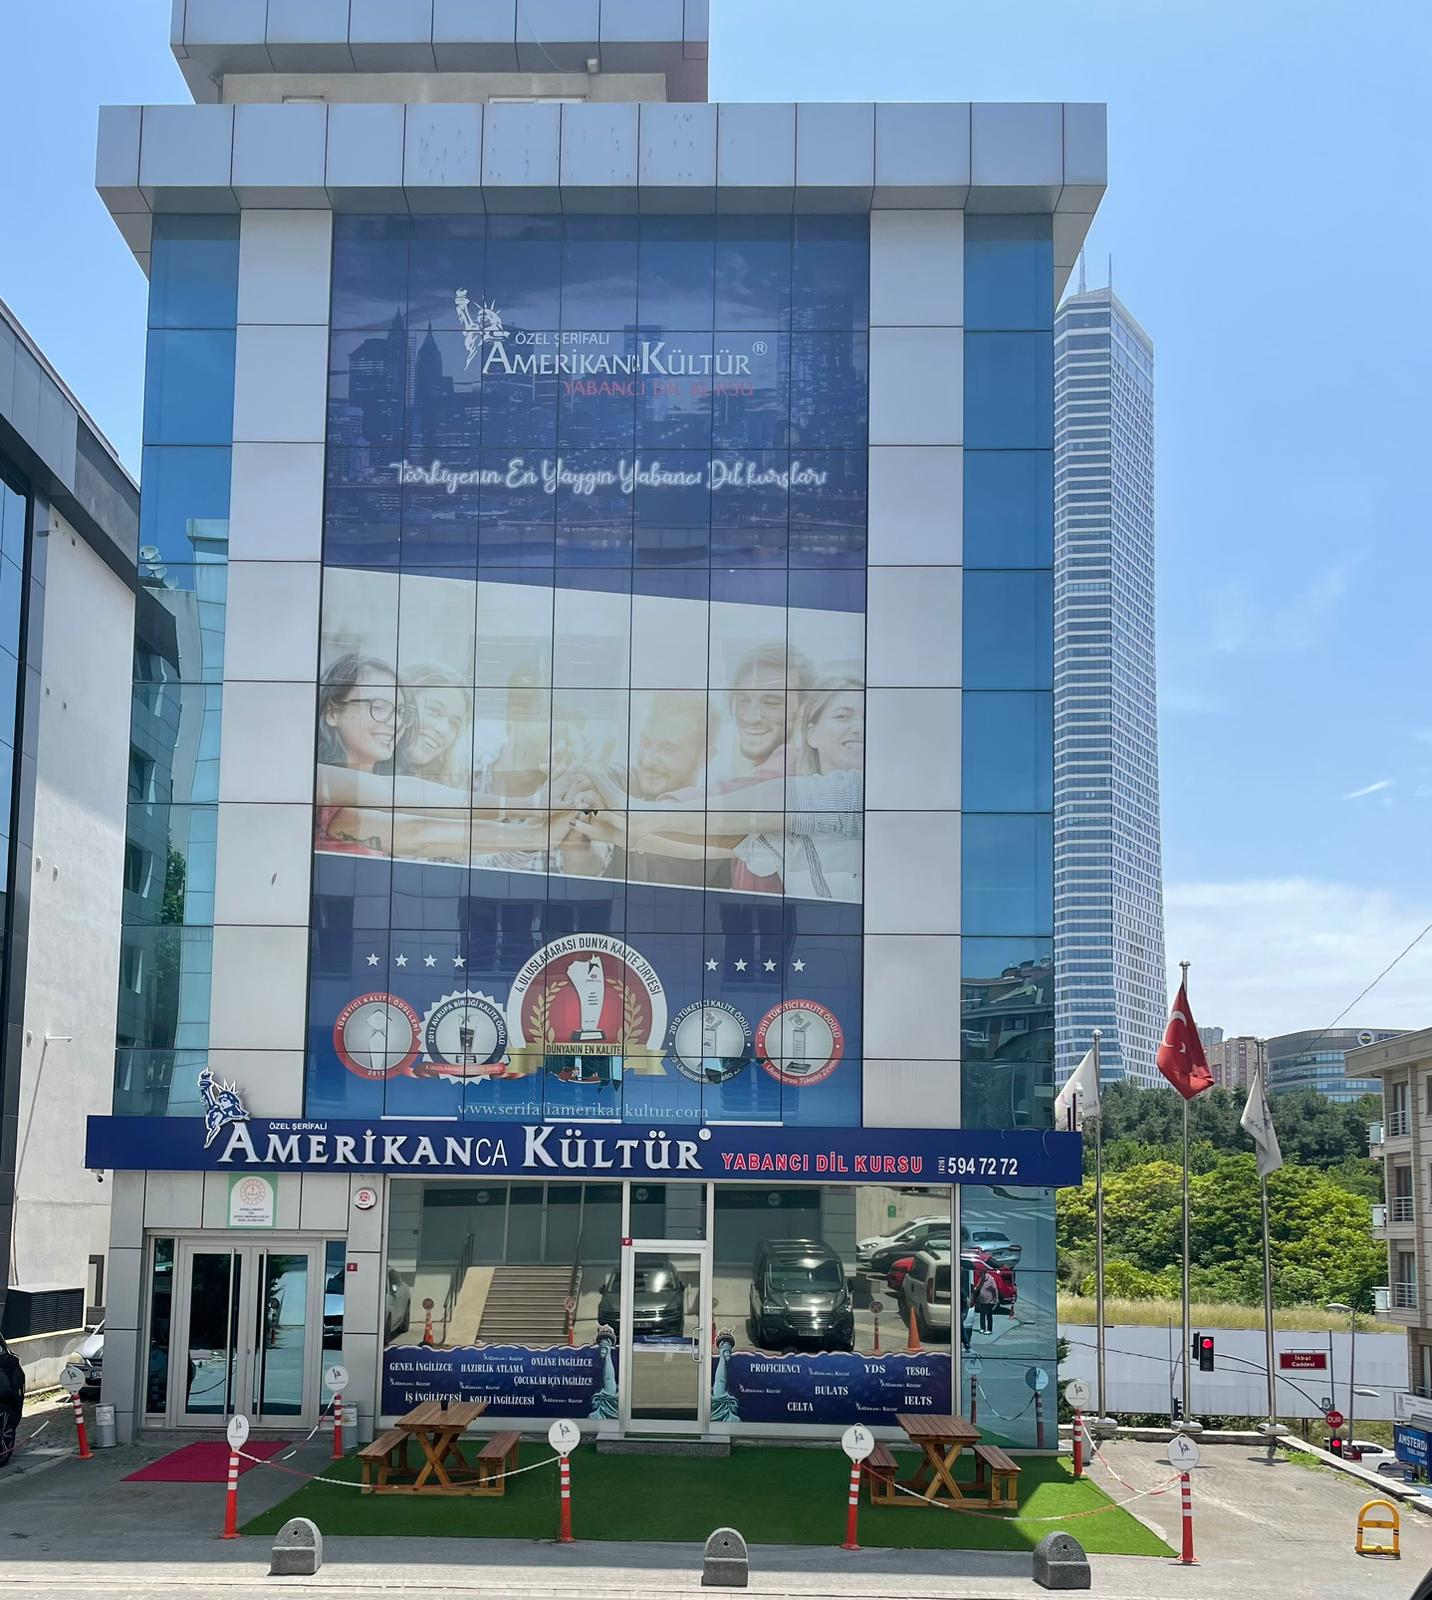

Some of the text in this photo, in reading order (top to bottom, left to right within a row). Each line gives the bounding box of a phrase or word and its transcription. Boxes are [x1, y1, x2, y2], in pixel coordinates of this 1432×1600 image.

[515, 331, 550, 345] ÖZEL
[641, 341, 751, 375] KÜLTÜR
[563, 380, 645, 397] YABANCI
[505, 457, 538, 488] En
[618, 459, 702, 493] Yabancı
[669, 1017, 681, 1035] 2010
[585, 1045, 595, 1054] EN
[269, 1121, 290, 1130] ÖZEL
[521, 1125, 703, 1170] KÜLTÜR
[721, 1152, 809, 1173] YABANCI
[816, 1151, 848, 1173] DİL
[854, 1155, 923, 1174] KURSU
[948, 1157, 976, 1175] 594
[979, 1157, 997, 1175] 72
[1000, 1158, 1018, 1176] 72
[389, 1361, 453, 1372] GENEL İNGİLİZCE
[460, 1364, 524, 1374] HAZIRLIK ATLAMA
[750, 1363, 802, 1374] PROFICIENCY
[864, 1364, 886, 1374] YDS
[905, 1366, 931, 1376] TESOL
[814, 1386, 848, 1396] BULATS
[787, 1402, 814, 1412] CELTA
[904, 1396, 932, 1406] IELTS
